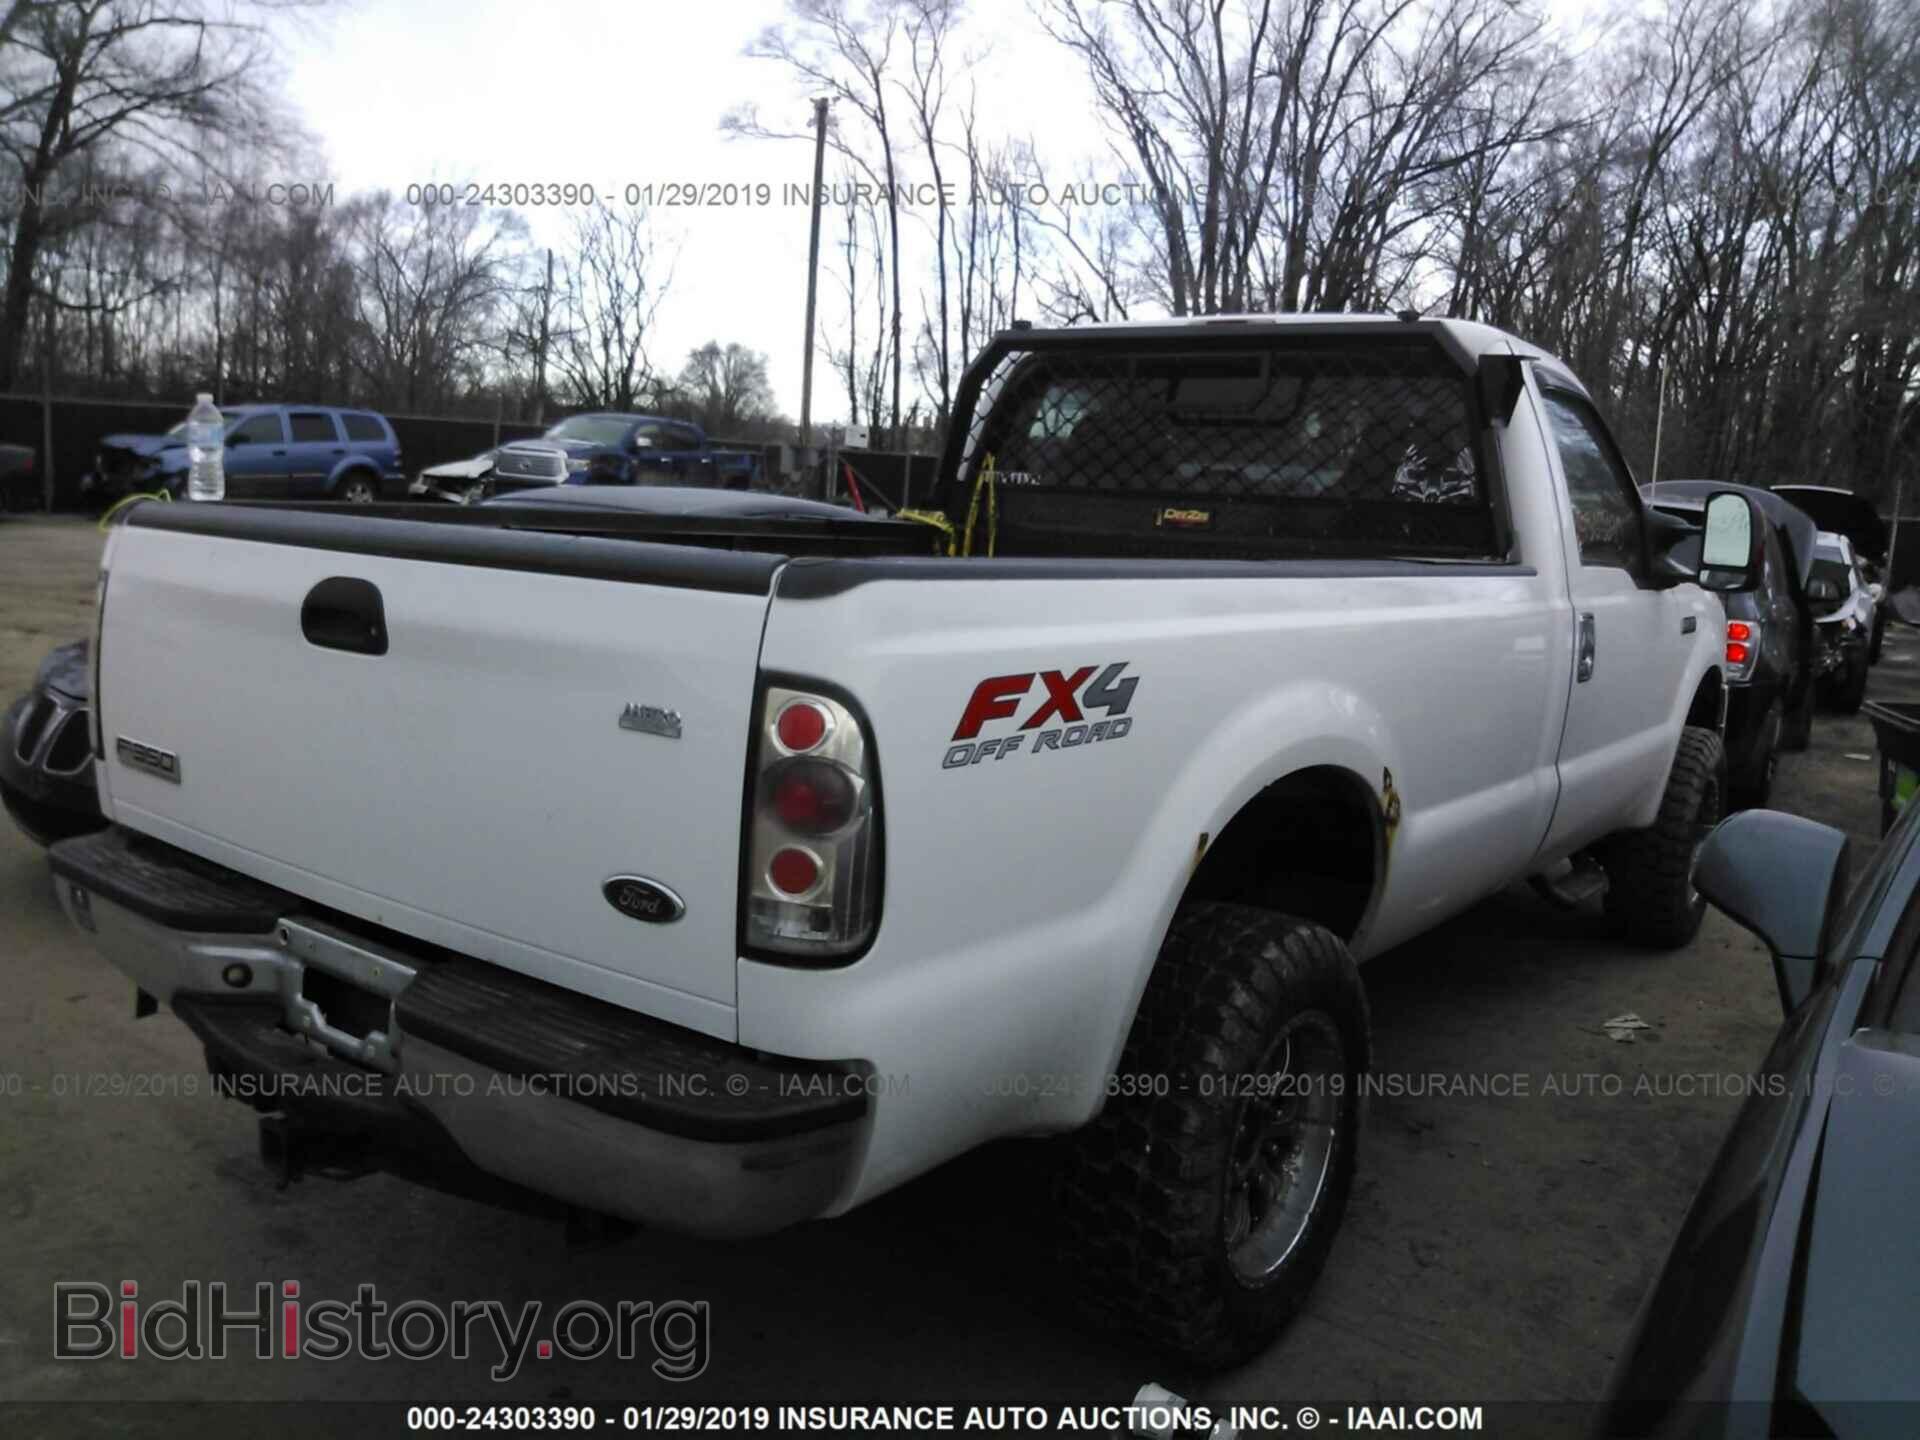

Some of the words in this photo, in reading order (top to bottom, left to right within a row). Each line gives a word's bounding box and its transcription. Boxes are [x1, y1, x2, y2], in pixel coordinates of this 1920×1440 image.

[951, 661, 1140, 742] FX4
[942, 734, 1025, 770] OFF
[1031, 717, 1132, 754] ROAD
